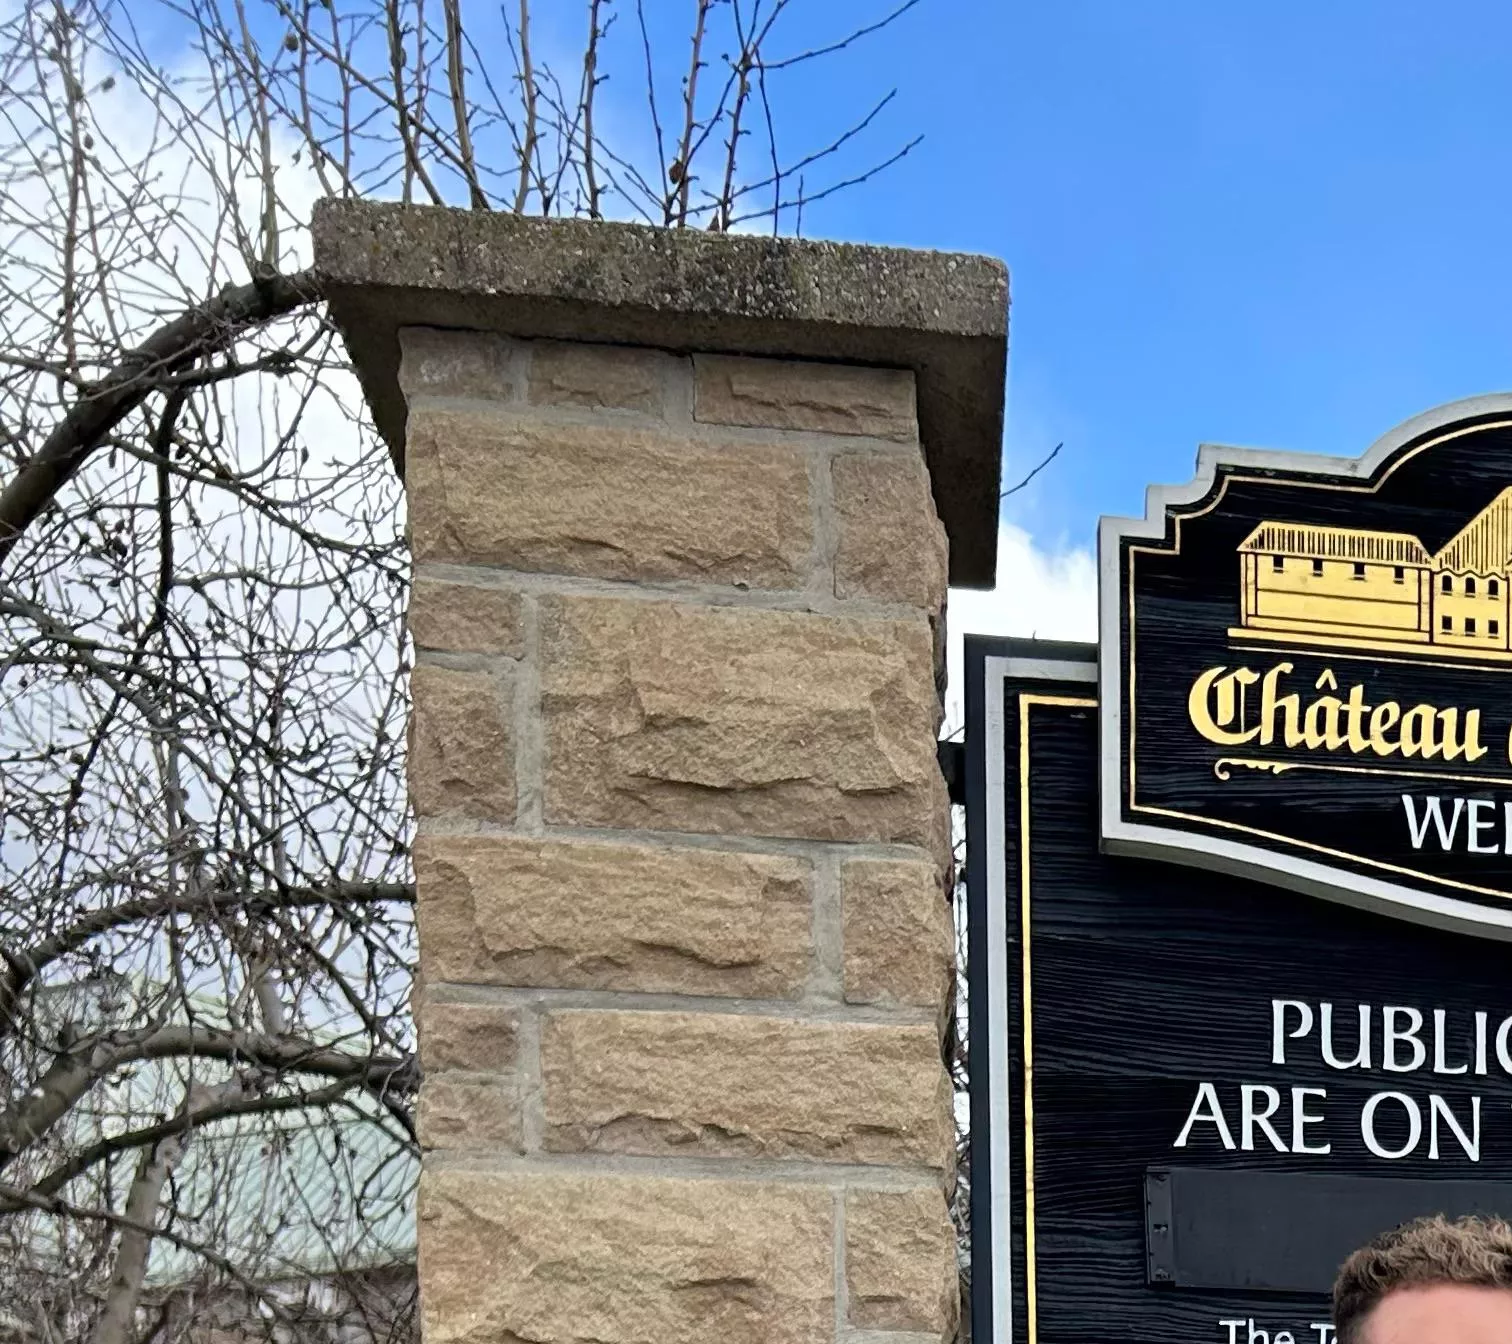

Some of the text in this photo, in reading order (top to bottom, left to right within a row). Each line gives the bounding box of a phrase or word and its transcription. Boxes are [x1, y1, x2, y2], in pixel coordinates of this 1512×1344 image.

[1188, 662, 1488, 760] Château
[1173, 1082, 1331, 1154] ARE
[1360, 1091, 1481, 1162] ON
